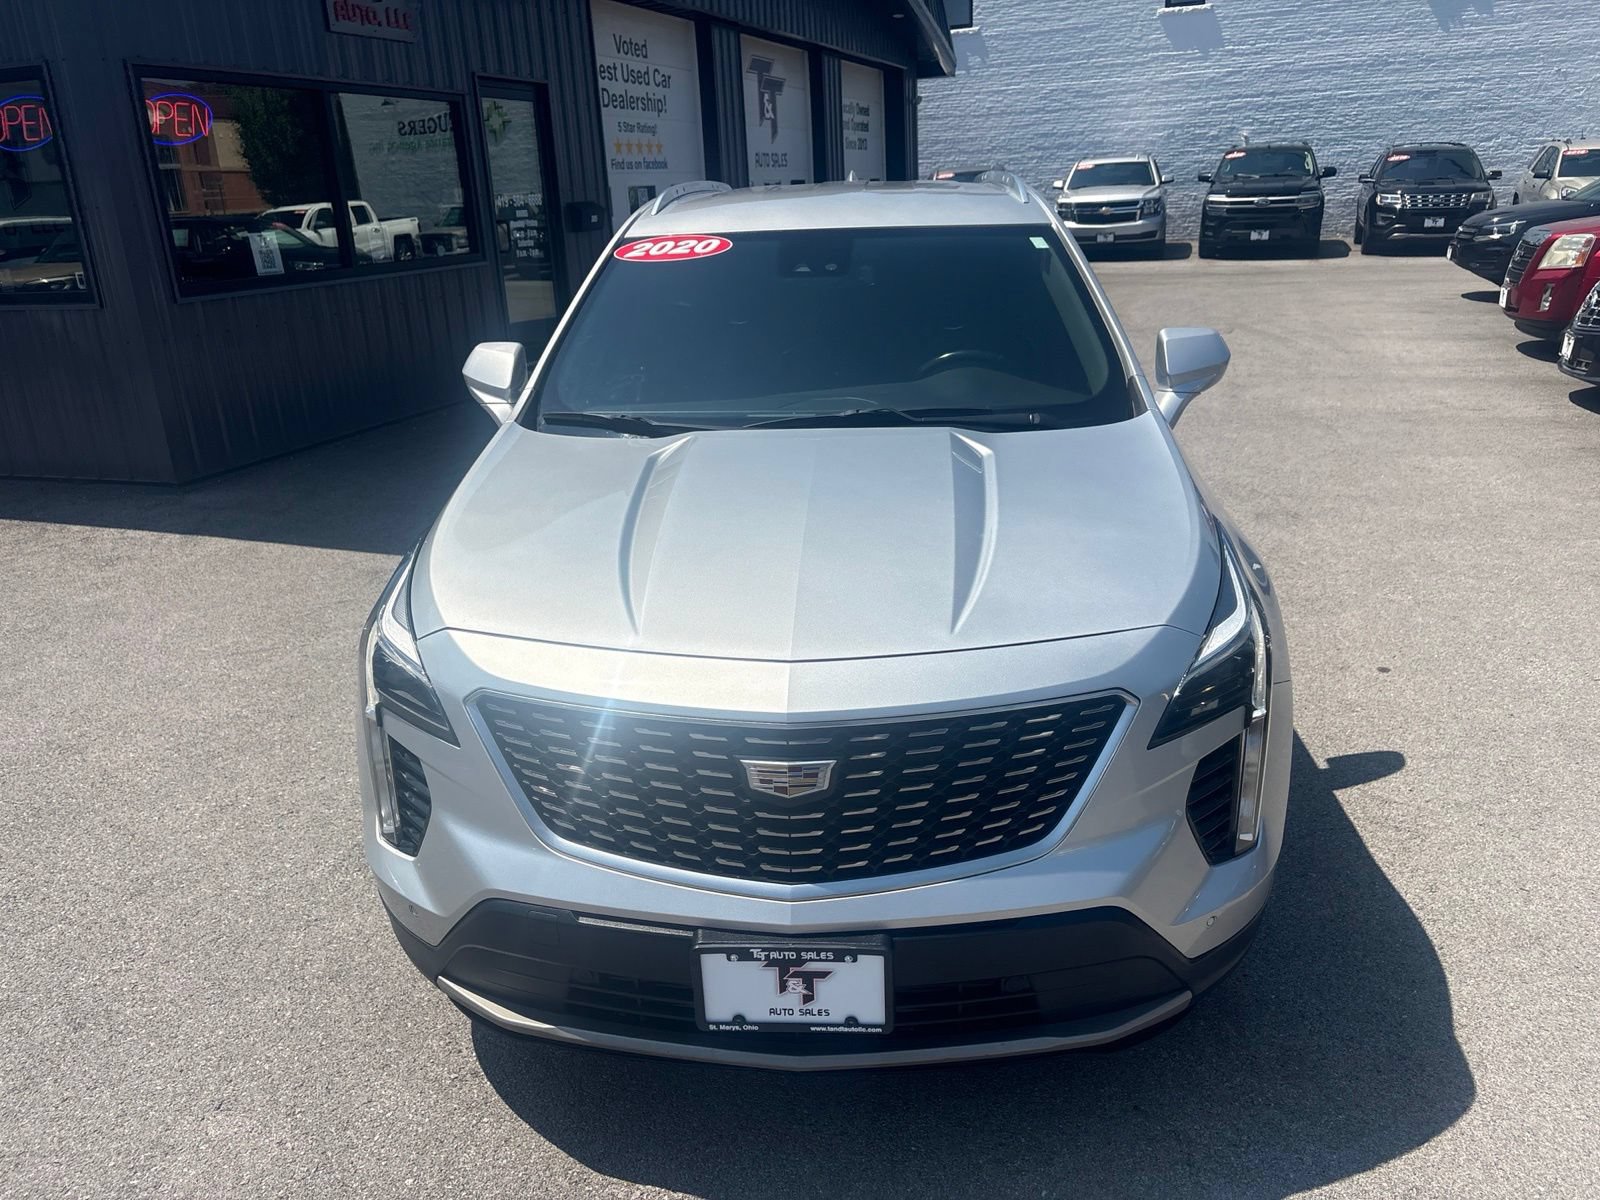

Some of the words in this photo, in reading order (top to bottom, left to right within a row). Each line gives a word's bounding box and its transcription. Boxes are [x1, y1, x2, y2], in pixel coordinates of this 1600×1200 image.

[613, 33, 648, 59] Voted
[621, 63, 650, 86] Used
[653, 68, 671, 88] Car
[601, 87, 668, 117] Dealership!
[0, 104, 53, 142] PEN
[617, 121, 622, 133] 5
[623, 121, 635, 133] Star
[636, 122, 658, 137] Rating!
[610, 158, 624, 170] Find
[625, 160, 633, 170] us
[635, 160, 642, 170] on
[643, 156, 668, 170] facebook
[755, 152, 770, 168] AUTO
[771, 152, 788, 168] SALES
[623, 239, 721, 258] 2020
[770, 951, 797, 960] AUTO
[801, 951, 834, 960] SALES
[760, 960, 833, 1006] T&T
[769, 1008, 795, 1017] AUTO
[798, 1008, 831, 1017] SALES
